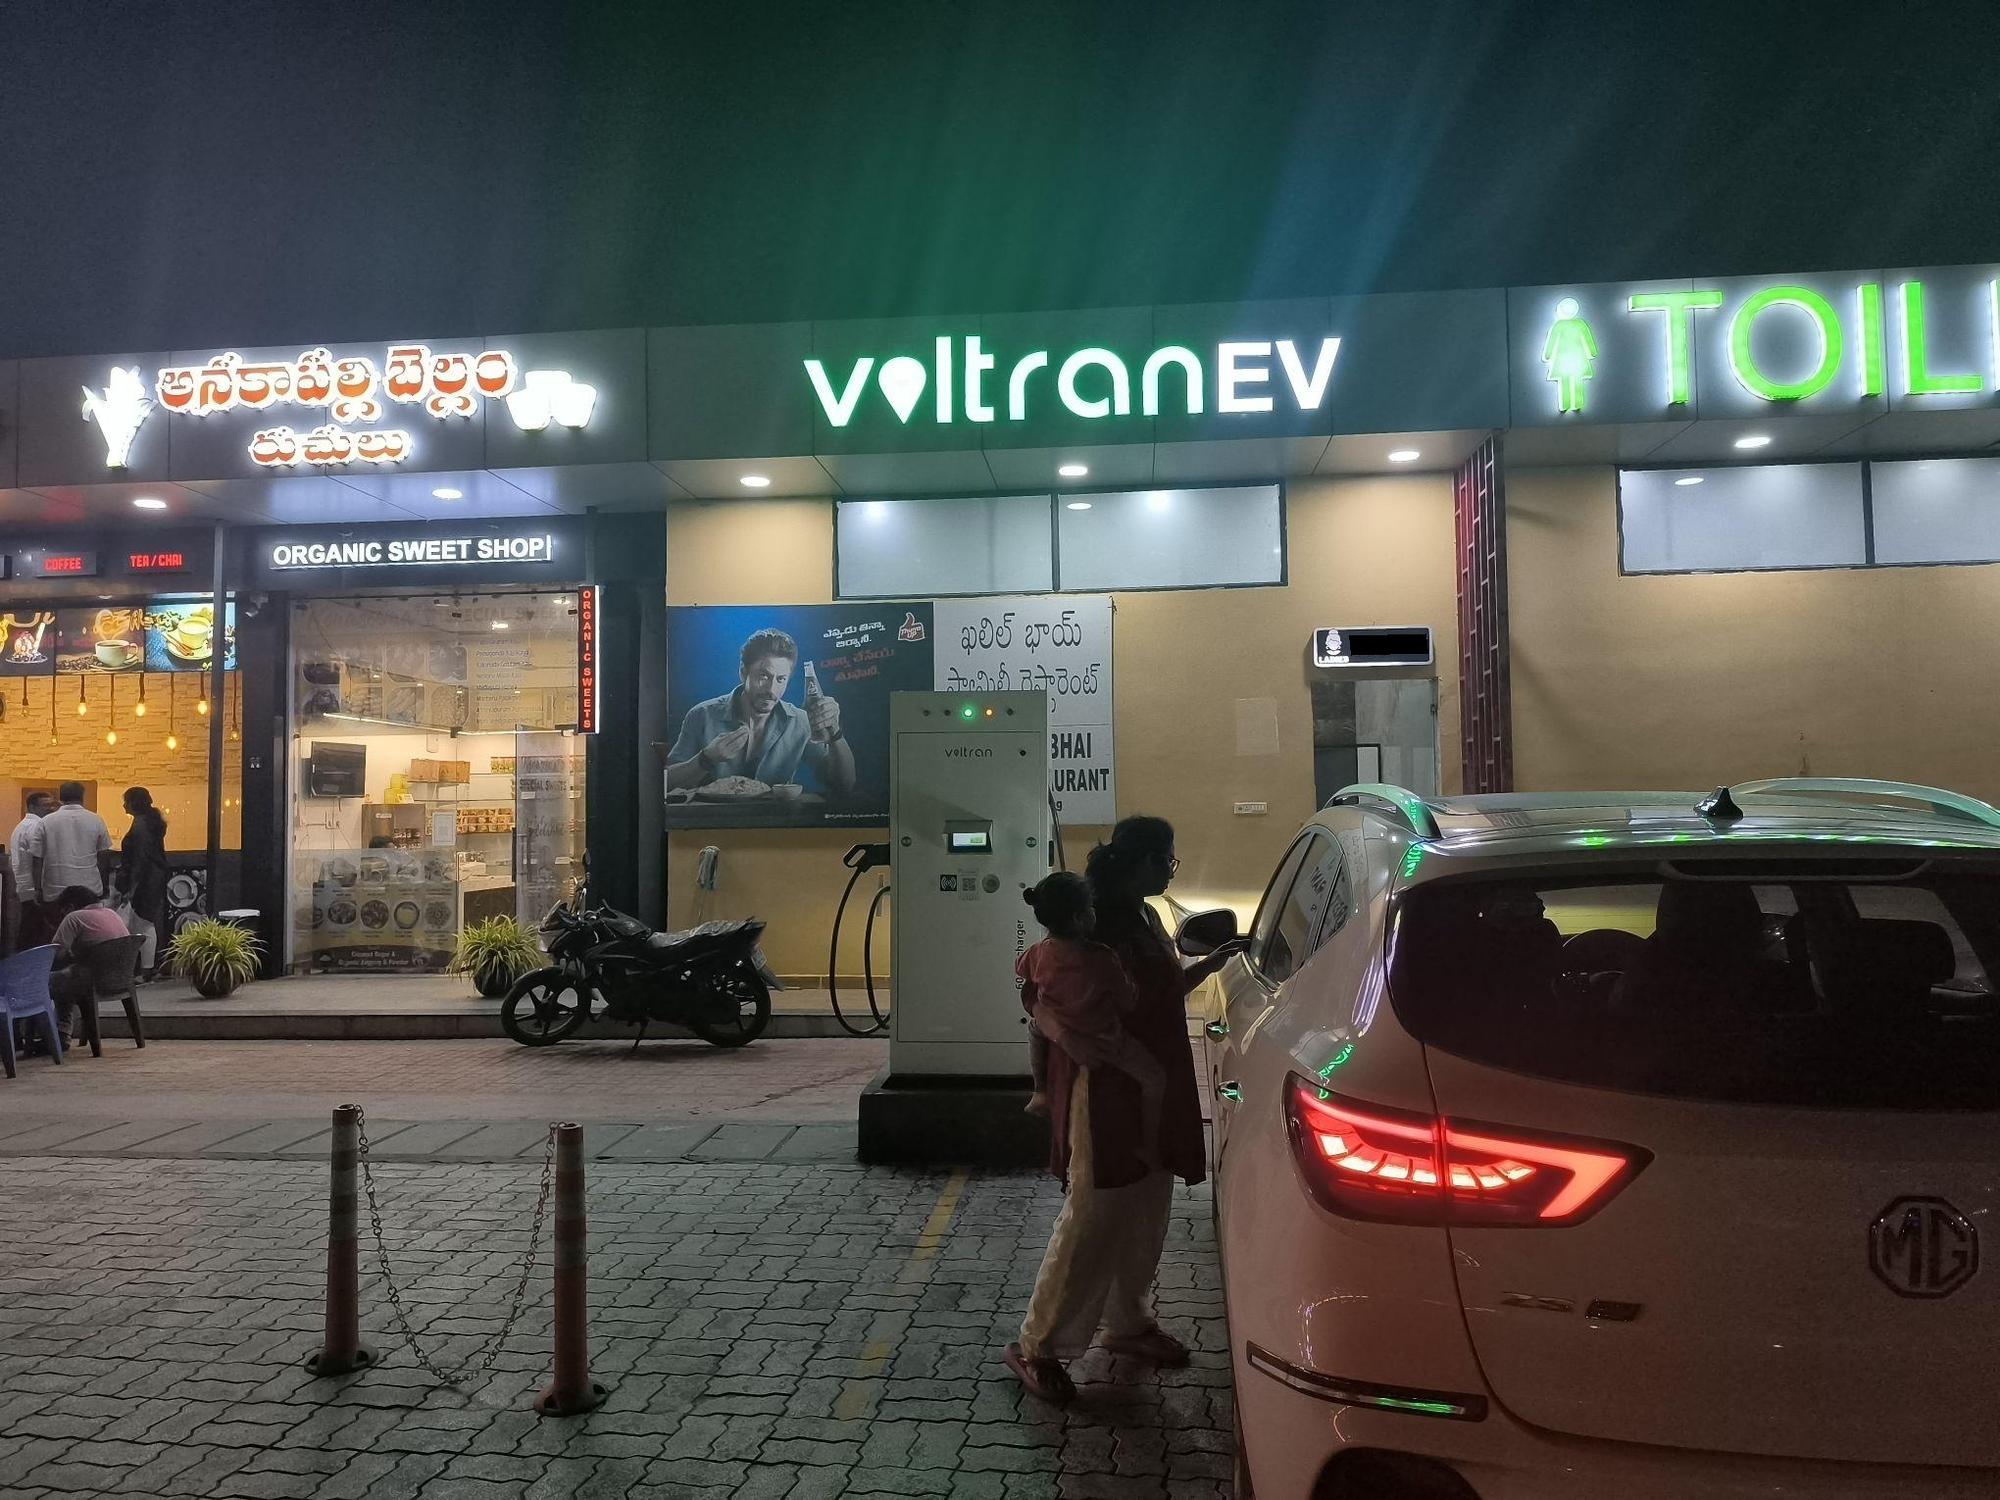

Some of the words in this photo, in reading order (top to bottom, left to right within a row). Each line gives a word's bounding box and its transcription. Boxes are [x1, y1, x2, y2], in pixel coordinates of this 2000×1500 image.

[1628, 280, 2000, 405] TOIL
[158, 348, 382, 423] అనకాపల్లి
[384, 345, 518, 419] బెల్లం
[249, 426, 410, 466] రుచులు
[44, 557, 82, 570] COFFEE
[273, 542, 382, 565] ORGANIC
[388, 539, 471, 562] SWEET
[477, 537, 545, 559] SHOP
[583, 590, 591, 661] ORGANIC
[1025, 611, 1081, 653] భాయ్
[582, 667, 592, 728] SWEETS
[1051, 732, 1091, 759] BHAI
[1051, 768, 1109, 792] URANT
[1879, 1204, 1972, 1291] MG
